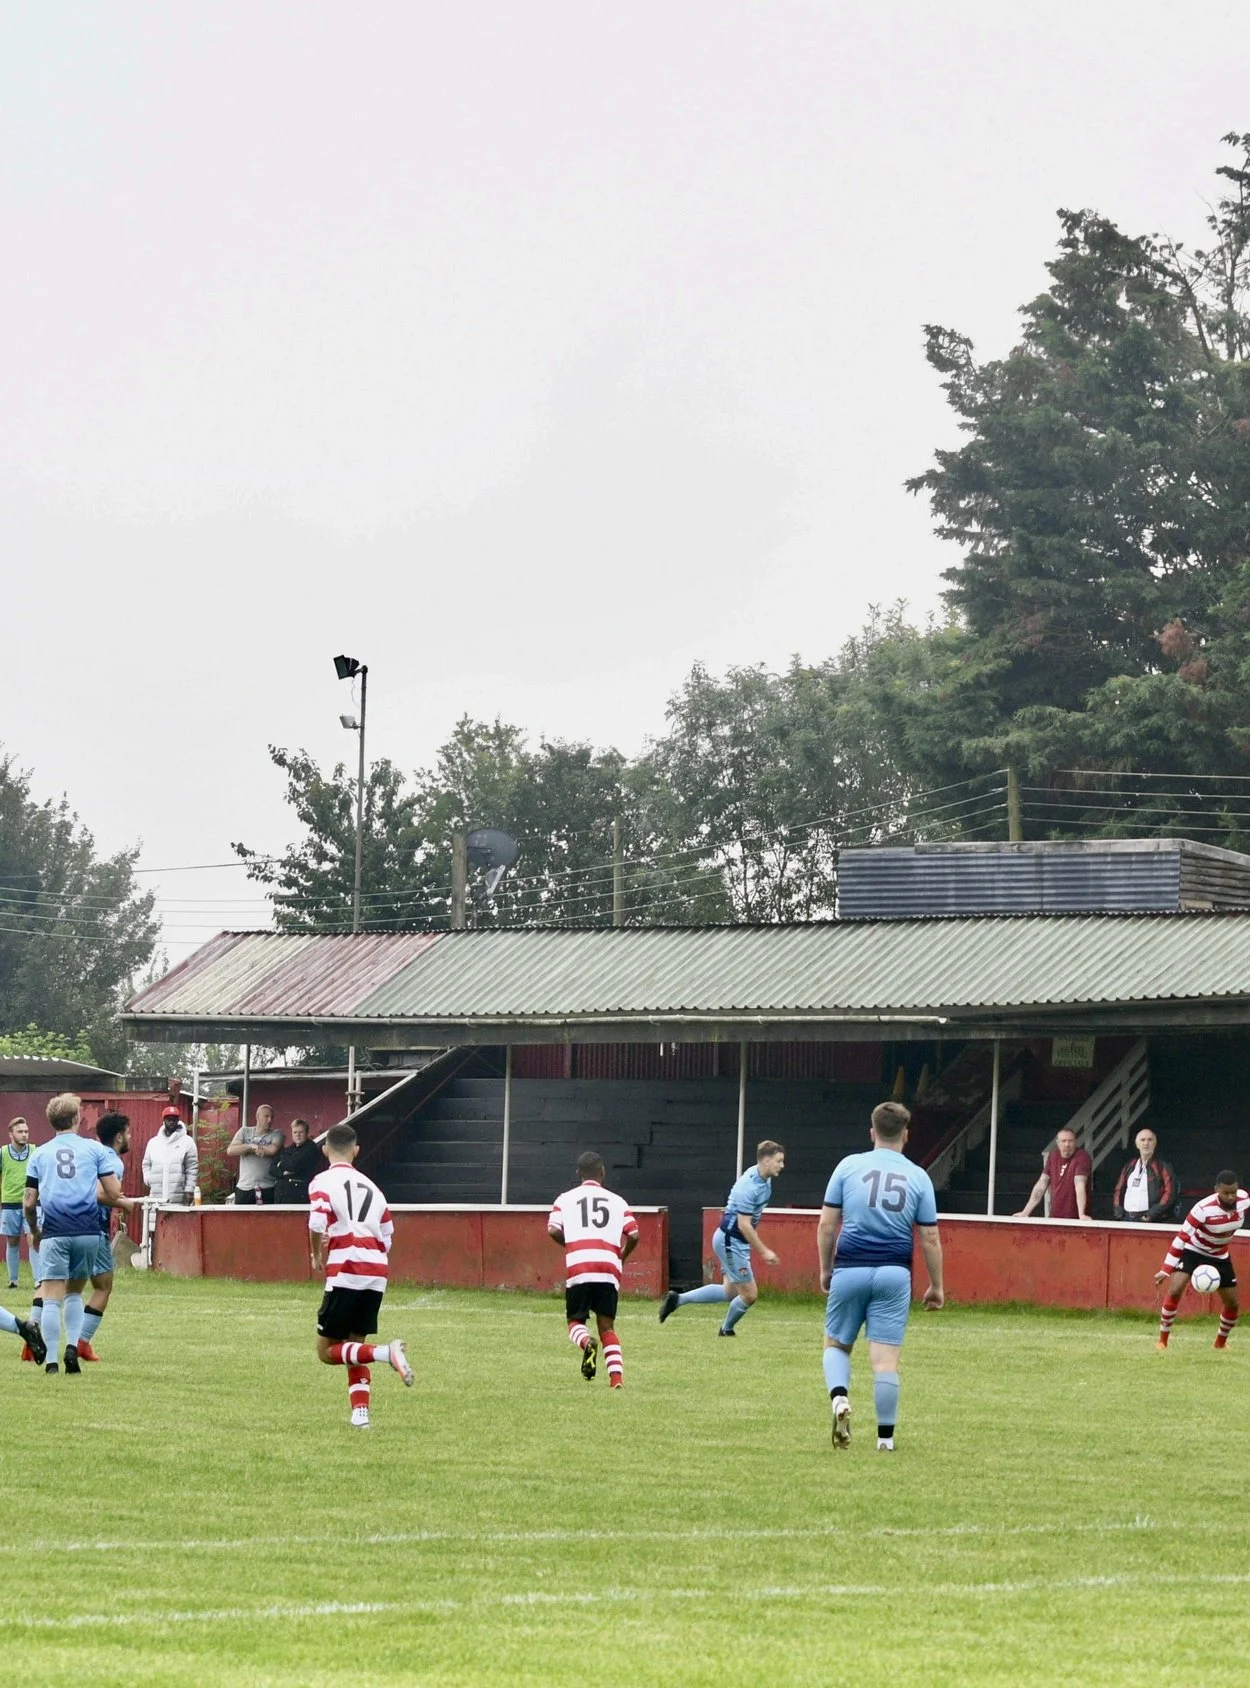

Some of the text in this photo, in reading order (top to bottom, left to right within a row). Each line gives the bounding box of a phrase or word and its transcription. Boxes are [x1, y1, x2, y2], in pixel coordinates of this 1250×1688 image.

[56, 1148, 76, 1180] 8
[343, 1179, 374, 1223] 17
[860, 1169, 908, 1213] 15
[576, 1196, 610, 1229] 15
